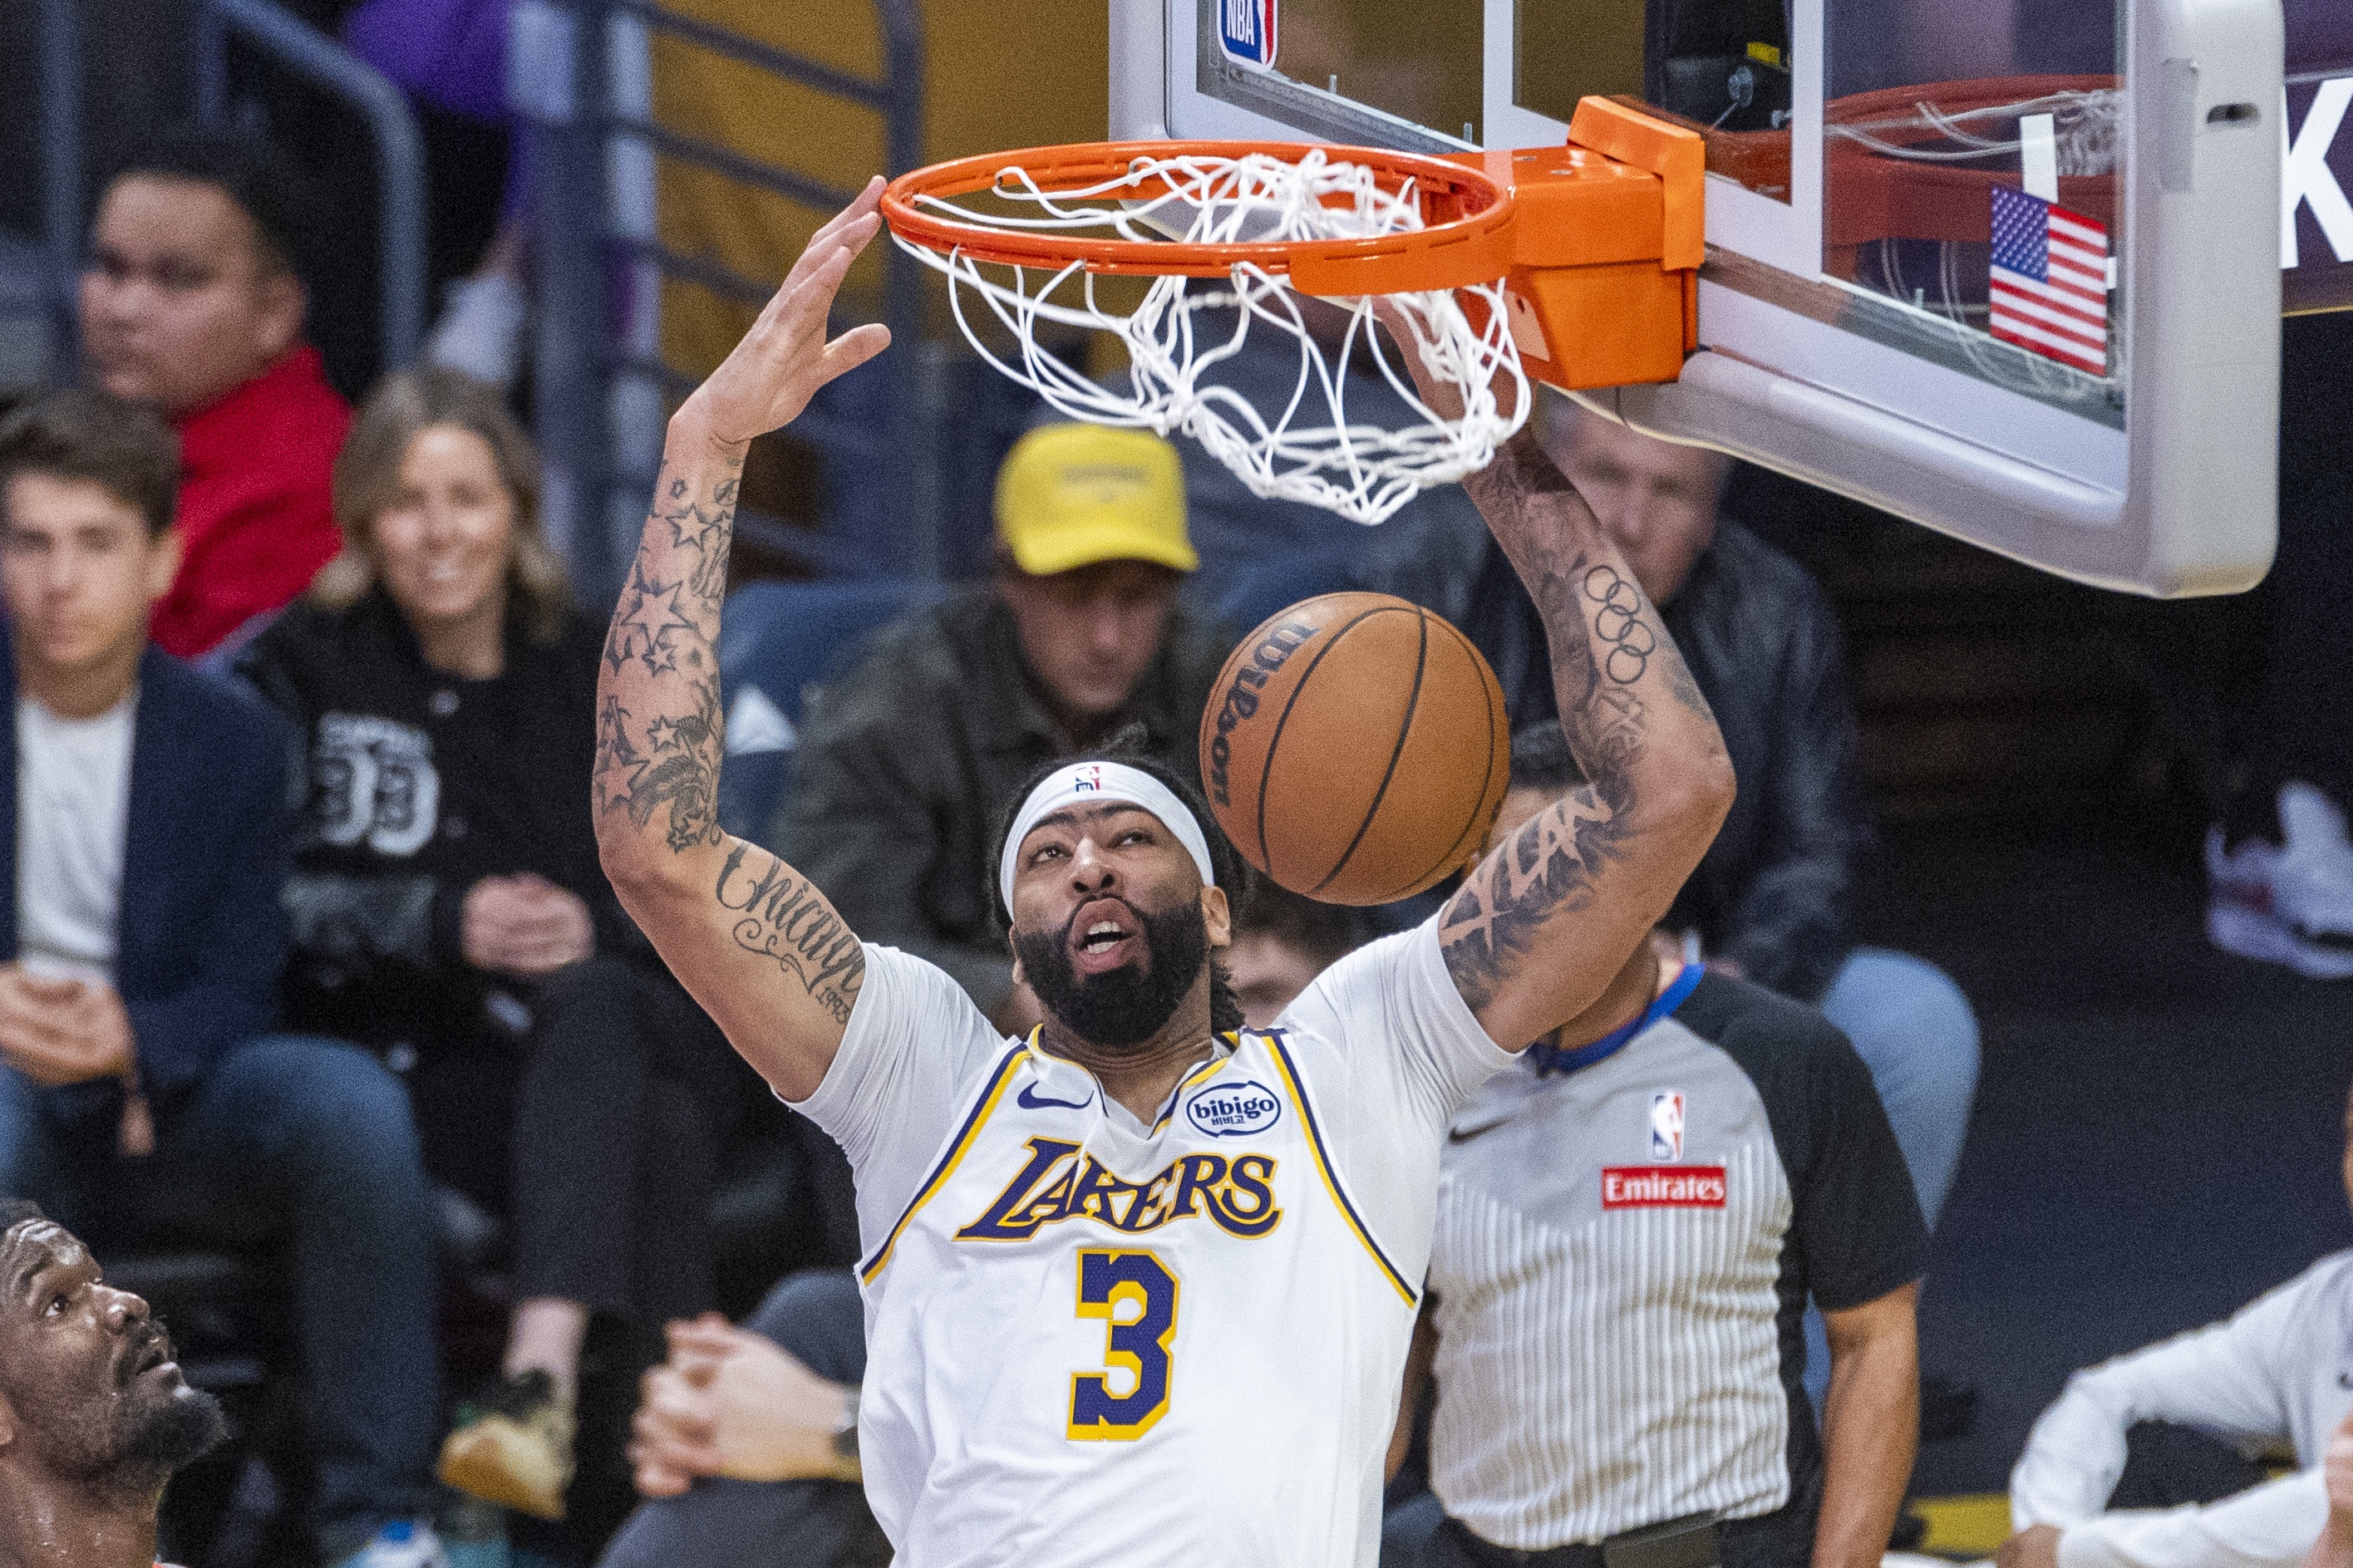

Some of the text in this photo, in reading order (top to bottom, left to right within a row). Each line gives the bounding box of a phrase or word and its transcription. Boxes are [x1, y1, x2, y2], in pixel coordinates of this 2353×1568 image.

[1227, 0, 1255, 47] NBA
[1194, 1096, 1274, 1119] bibigo
[1211, 1115, 1245, 1125] 비비고
[952, 1134, 1285, 1241] LAKERS
[1605, 1169, 1725, 1202] Emirates
[1066, 1247, 1182, 1442] 3
